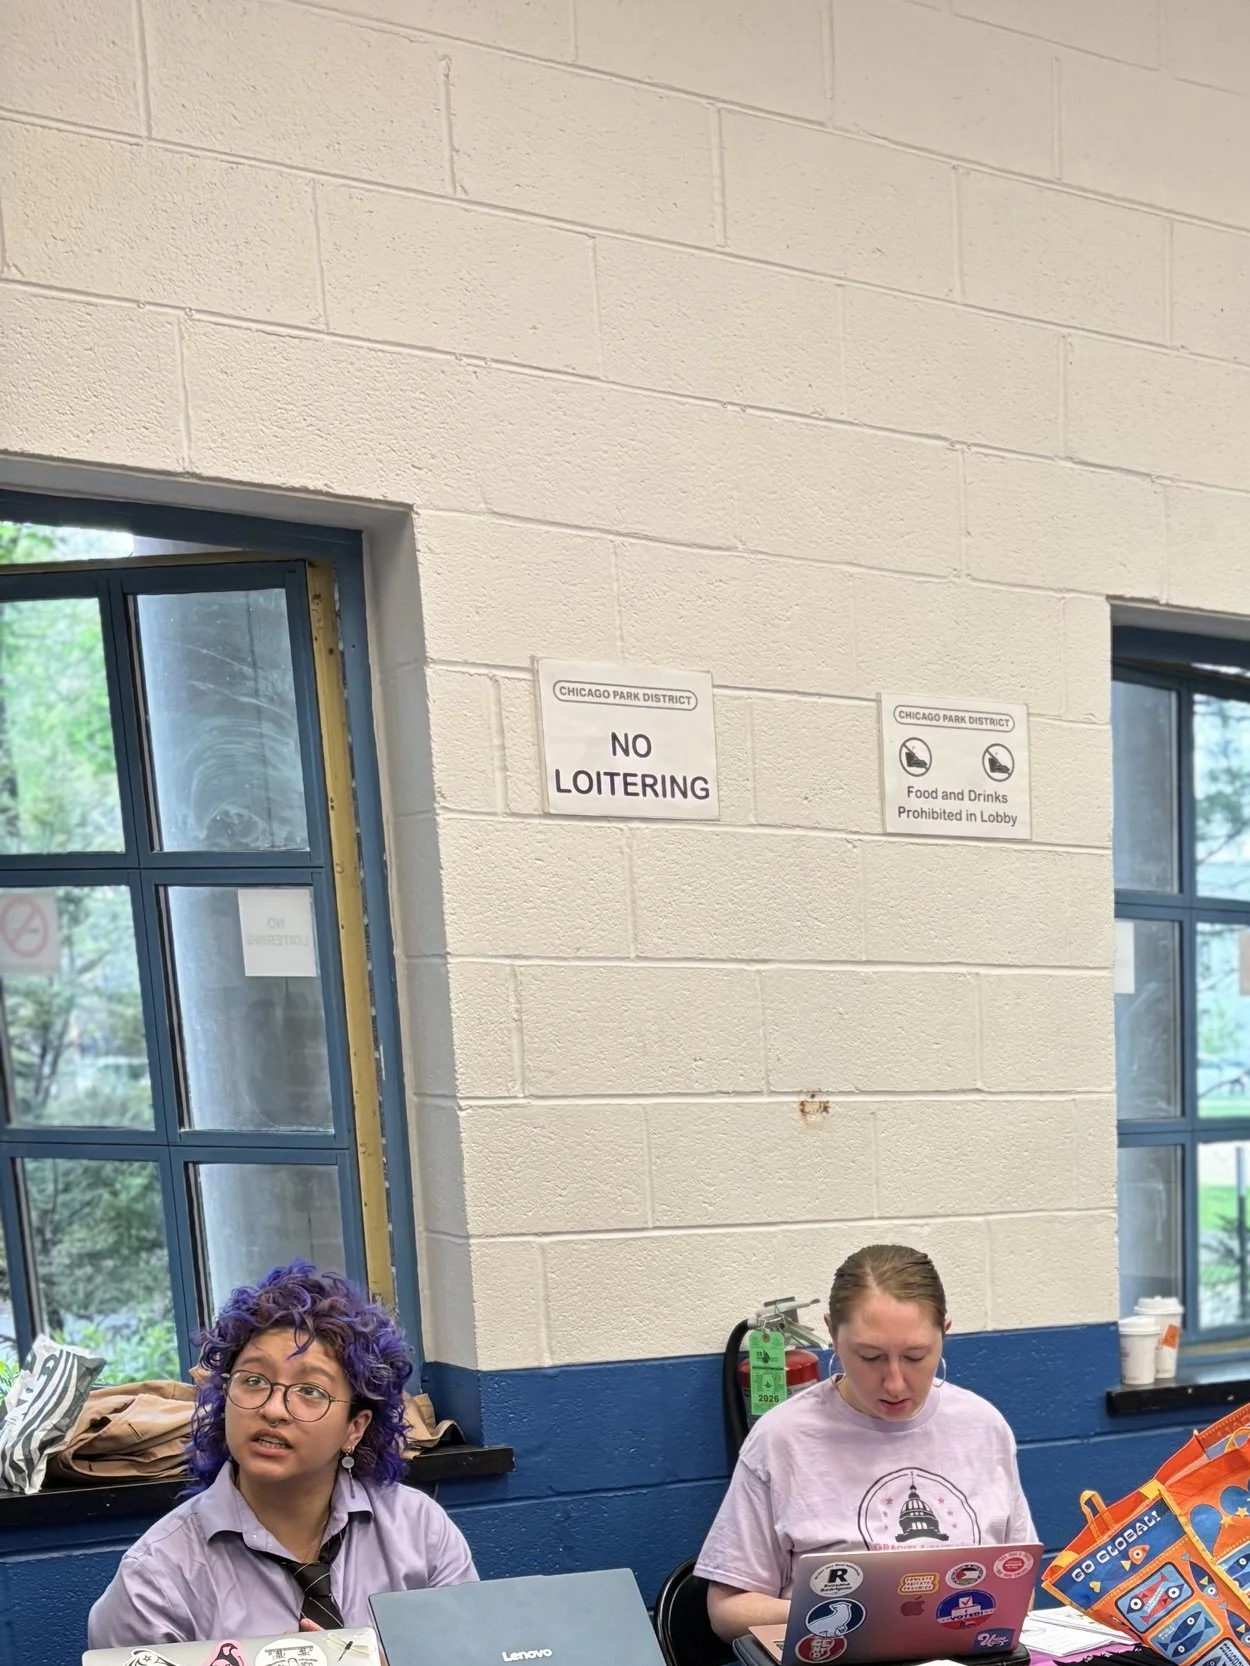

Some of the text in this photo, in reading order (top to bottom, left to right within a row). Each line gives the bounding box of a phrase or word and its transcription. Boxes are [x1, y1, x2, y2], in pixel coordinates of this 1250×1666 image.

[558, 685, 693, 707] CHICAGO PARK DISTRICT
[898, 709, 1011, 730] CHICAGO PARK DISTRICT
[610, 732, 652, 759] NO
[555, 768, 711, 801] LOITERING
[906, 785, 1009, 805] Food and Drinks
[897, 805, 1018, 828] Prohibited in Lobby
[1071, 1560, 1095, 1582] GO
[1096, 1511, 1160, 1563] GLOBAL!
[950, 1611, 984, 1621] VOTED!
[502, 1648, 552, 1662] Lenovo
